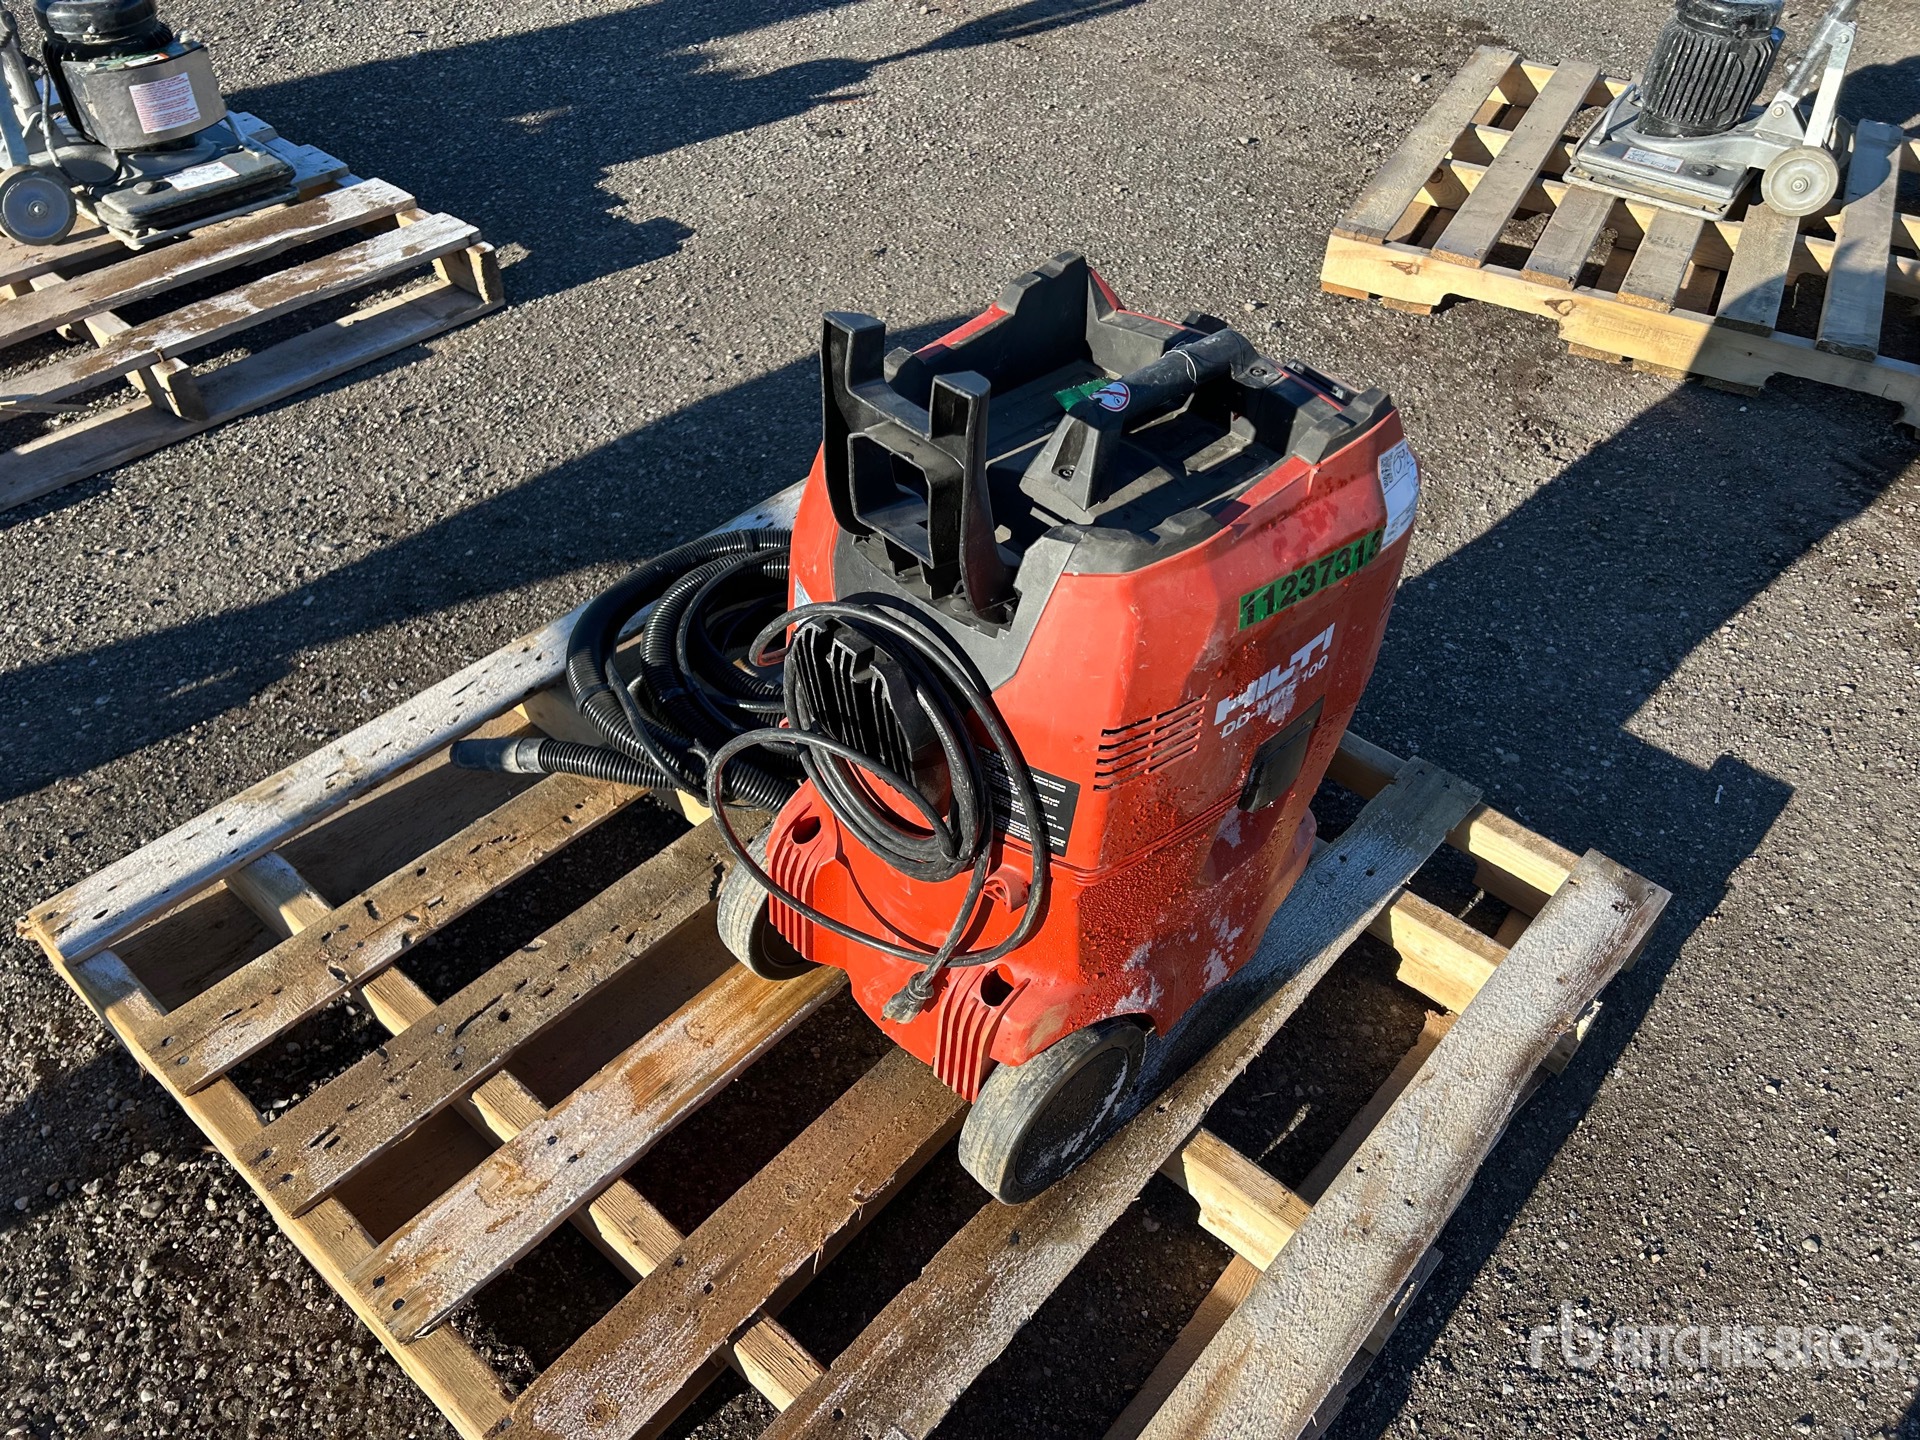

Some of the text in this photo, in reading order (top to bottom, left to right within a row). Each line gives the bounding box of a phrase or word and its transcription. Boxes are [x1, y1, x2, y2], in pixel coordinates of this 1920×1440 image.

[1242, 529, 1383, 625] 11237313
[1214, 622, 1336, 726] HILTI
[1221, 655, 1329, 739] DD-WMS 100
